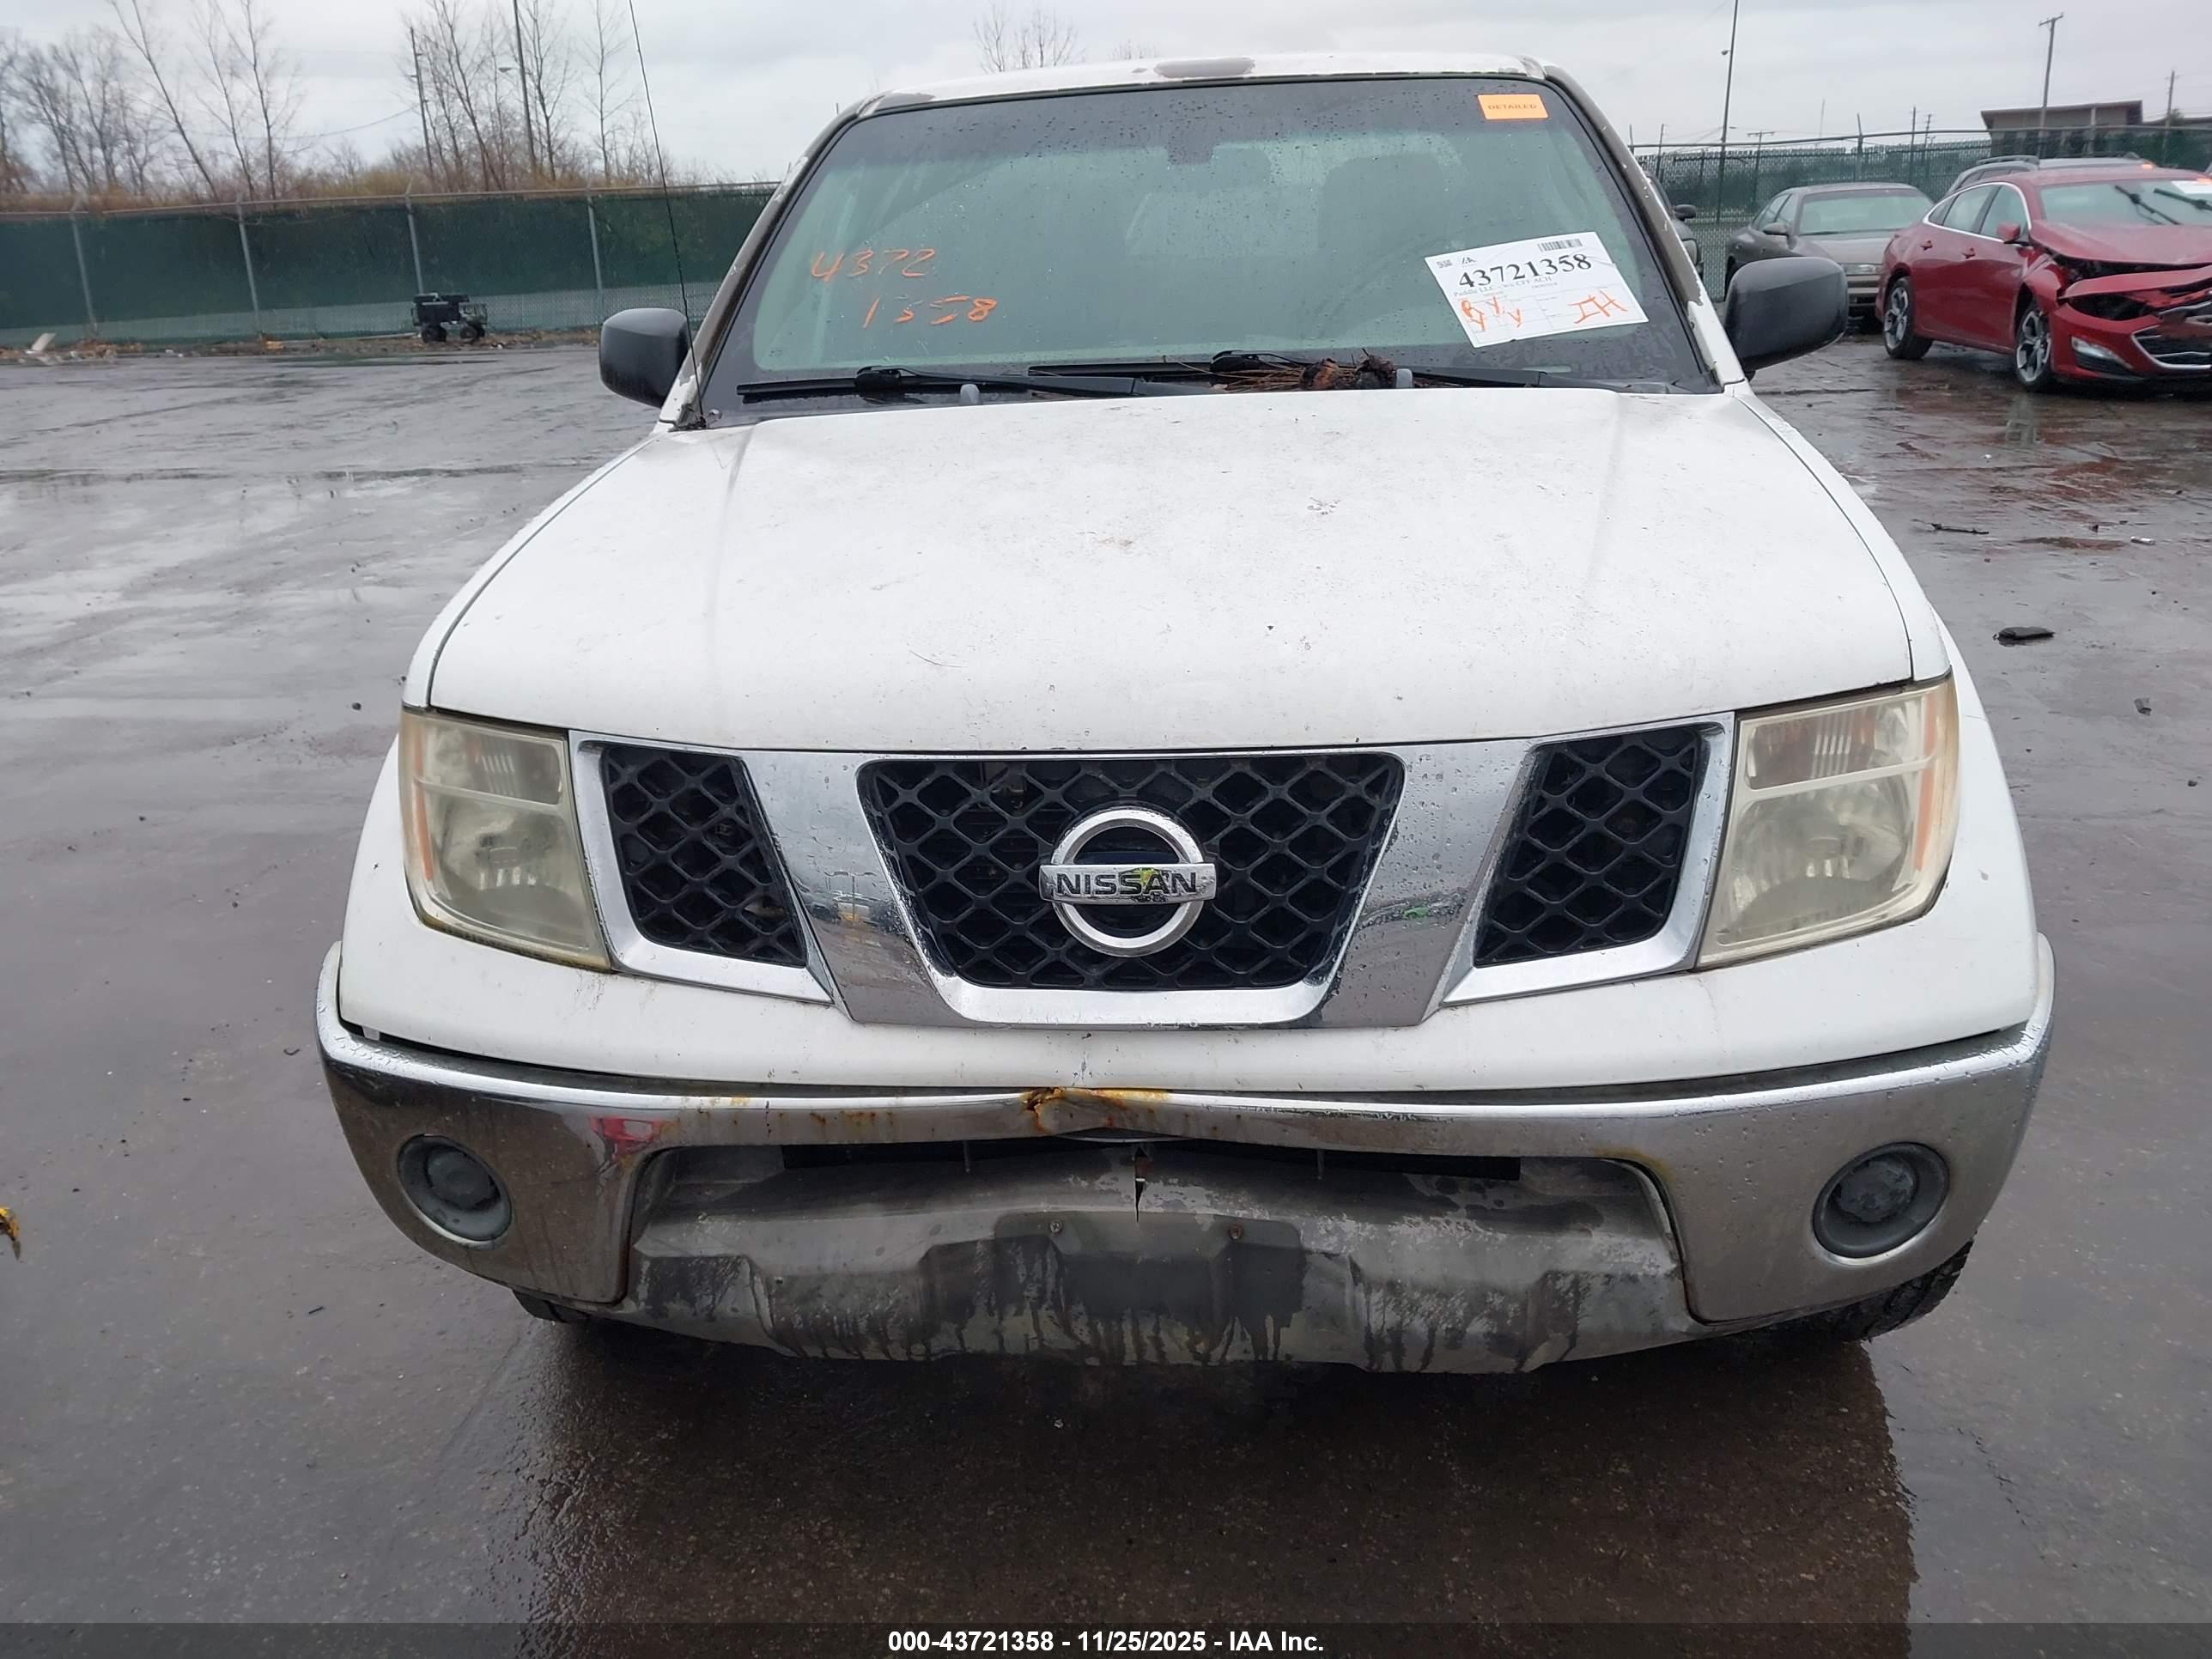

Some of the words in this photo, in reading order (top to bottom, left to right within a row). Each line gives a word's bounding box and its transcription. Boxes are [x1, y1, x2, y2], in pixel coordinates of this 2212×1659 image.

[811, 248, 936, 283] 4372
[1458, 252, 1592, 289] 43721358
[1056, 872, 1197, 896] NISSAN
